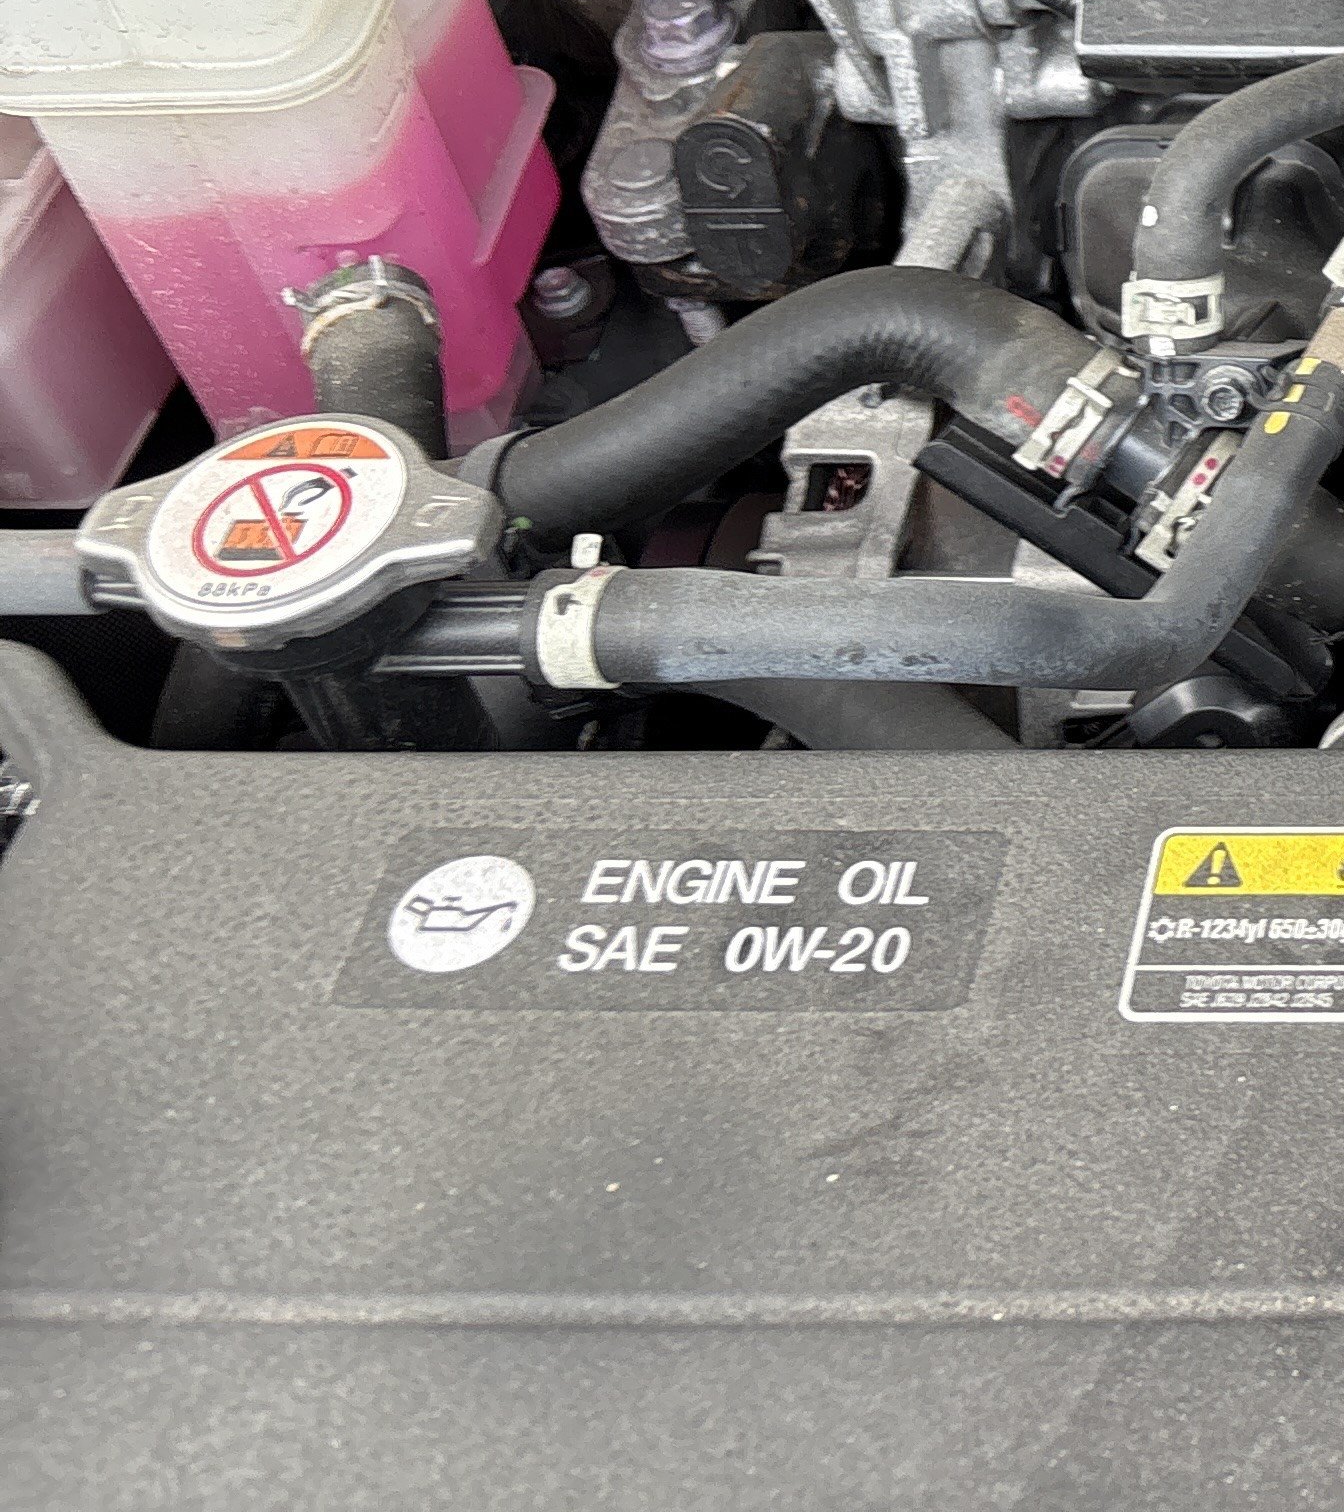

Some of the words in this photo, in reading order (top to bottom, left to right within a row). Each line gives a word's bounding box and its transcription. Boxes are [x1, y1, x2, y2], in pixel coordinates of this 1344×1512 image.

[581, 859, 806, 905] ENGINE
[838, 859, 931, 906] OIL
[558, 925, 690, 973] SAE
[724, 925, 912, 974] 0W-20
